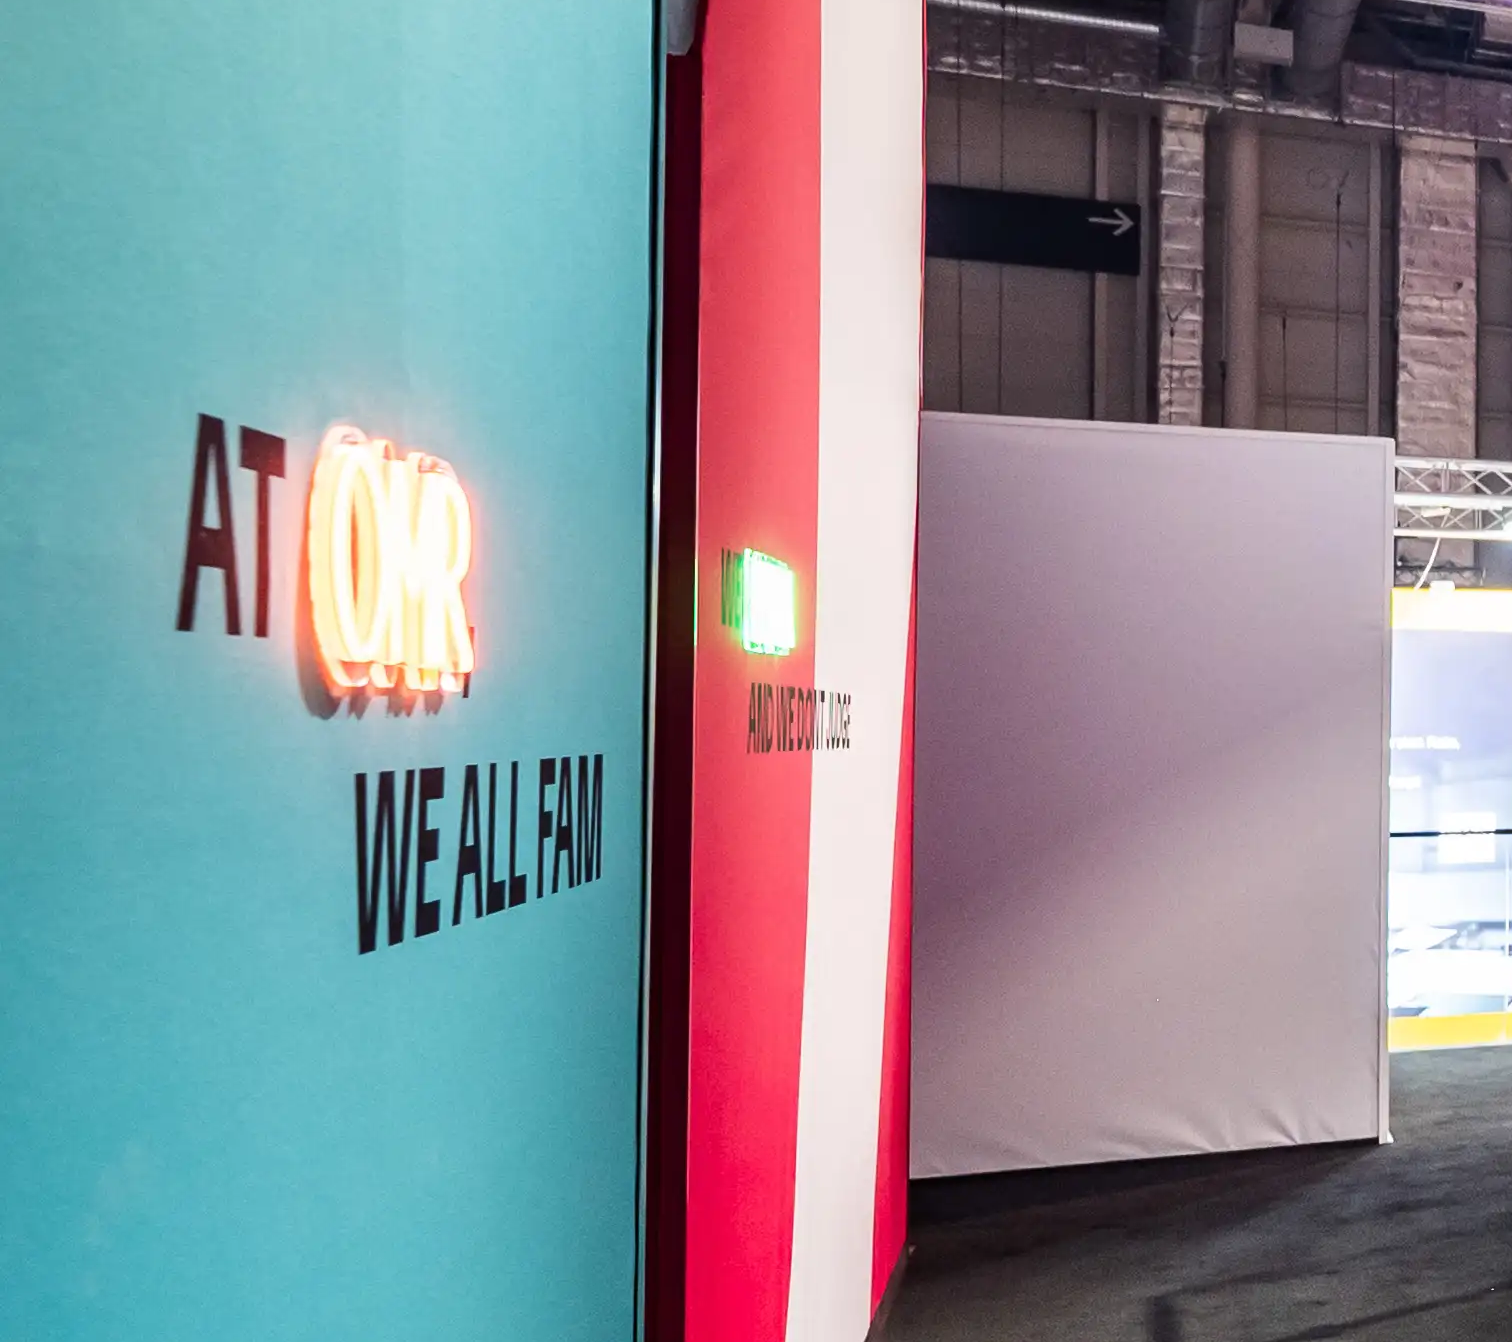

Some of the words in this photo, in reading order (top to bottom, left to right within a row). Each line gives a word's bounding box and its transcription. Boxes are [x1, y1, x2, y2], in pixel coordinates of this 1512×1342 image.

[176, 413, 286, 638] AT
[747, 682, 774, 754] AND
[776, 685, 795, 752] WE
[355, 766, 445, 955] WE
[452, 760, 527, 927] ALL
[537, 754, 603, 899] FAM
